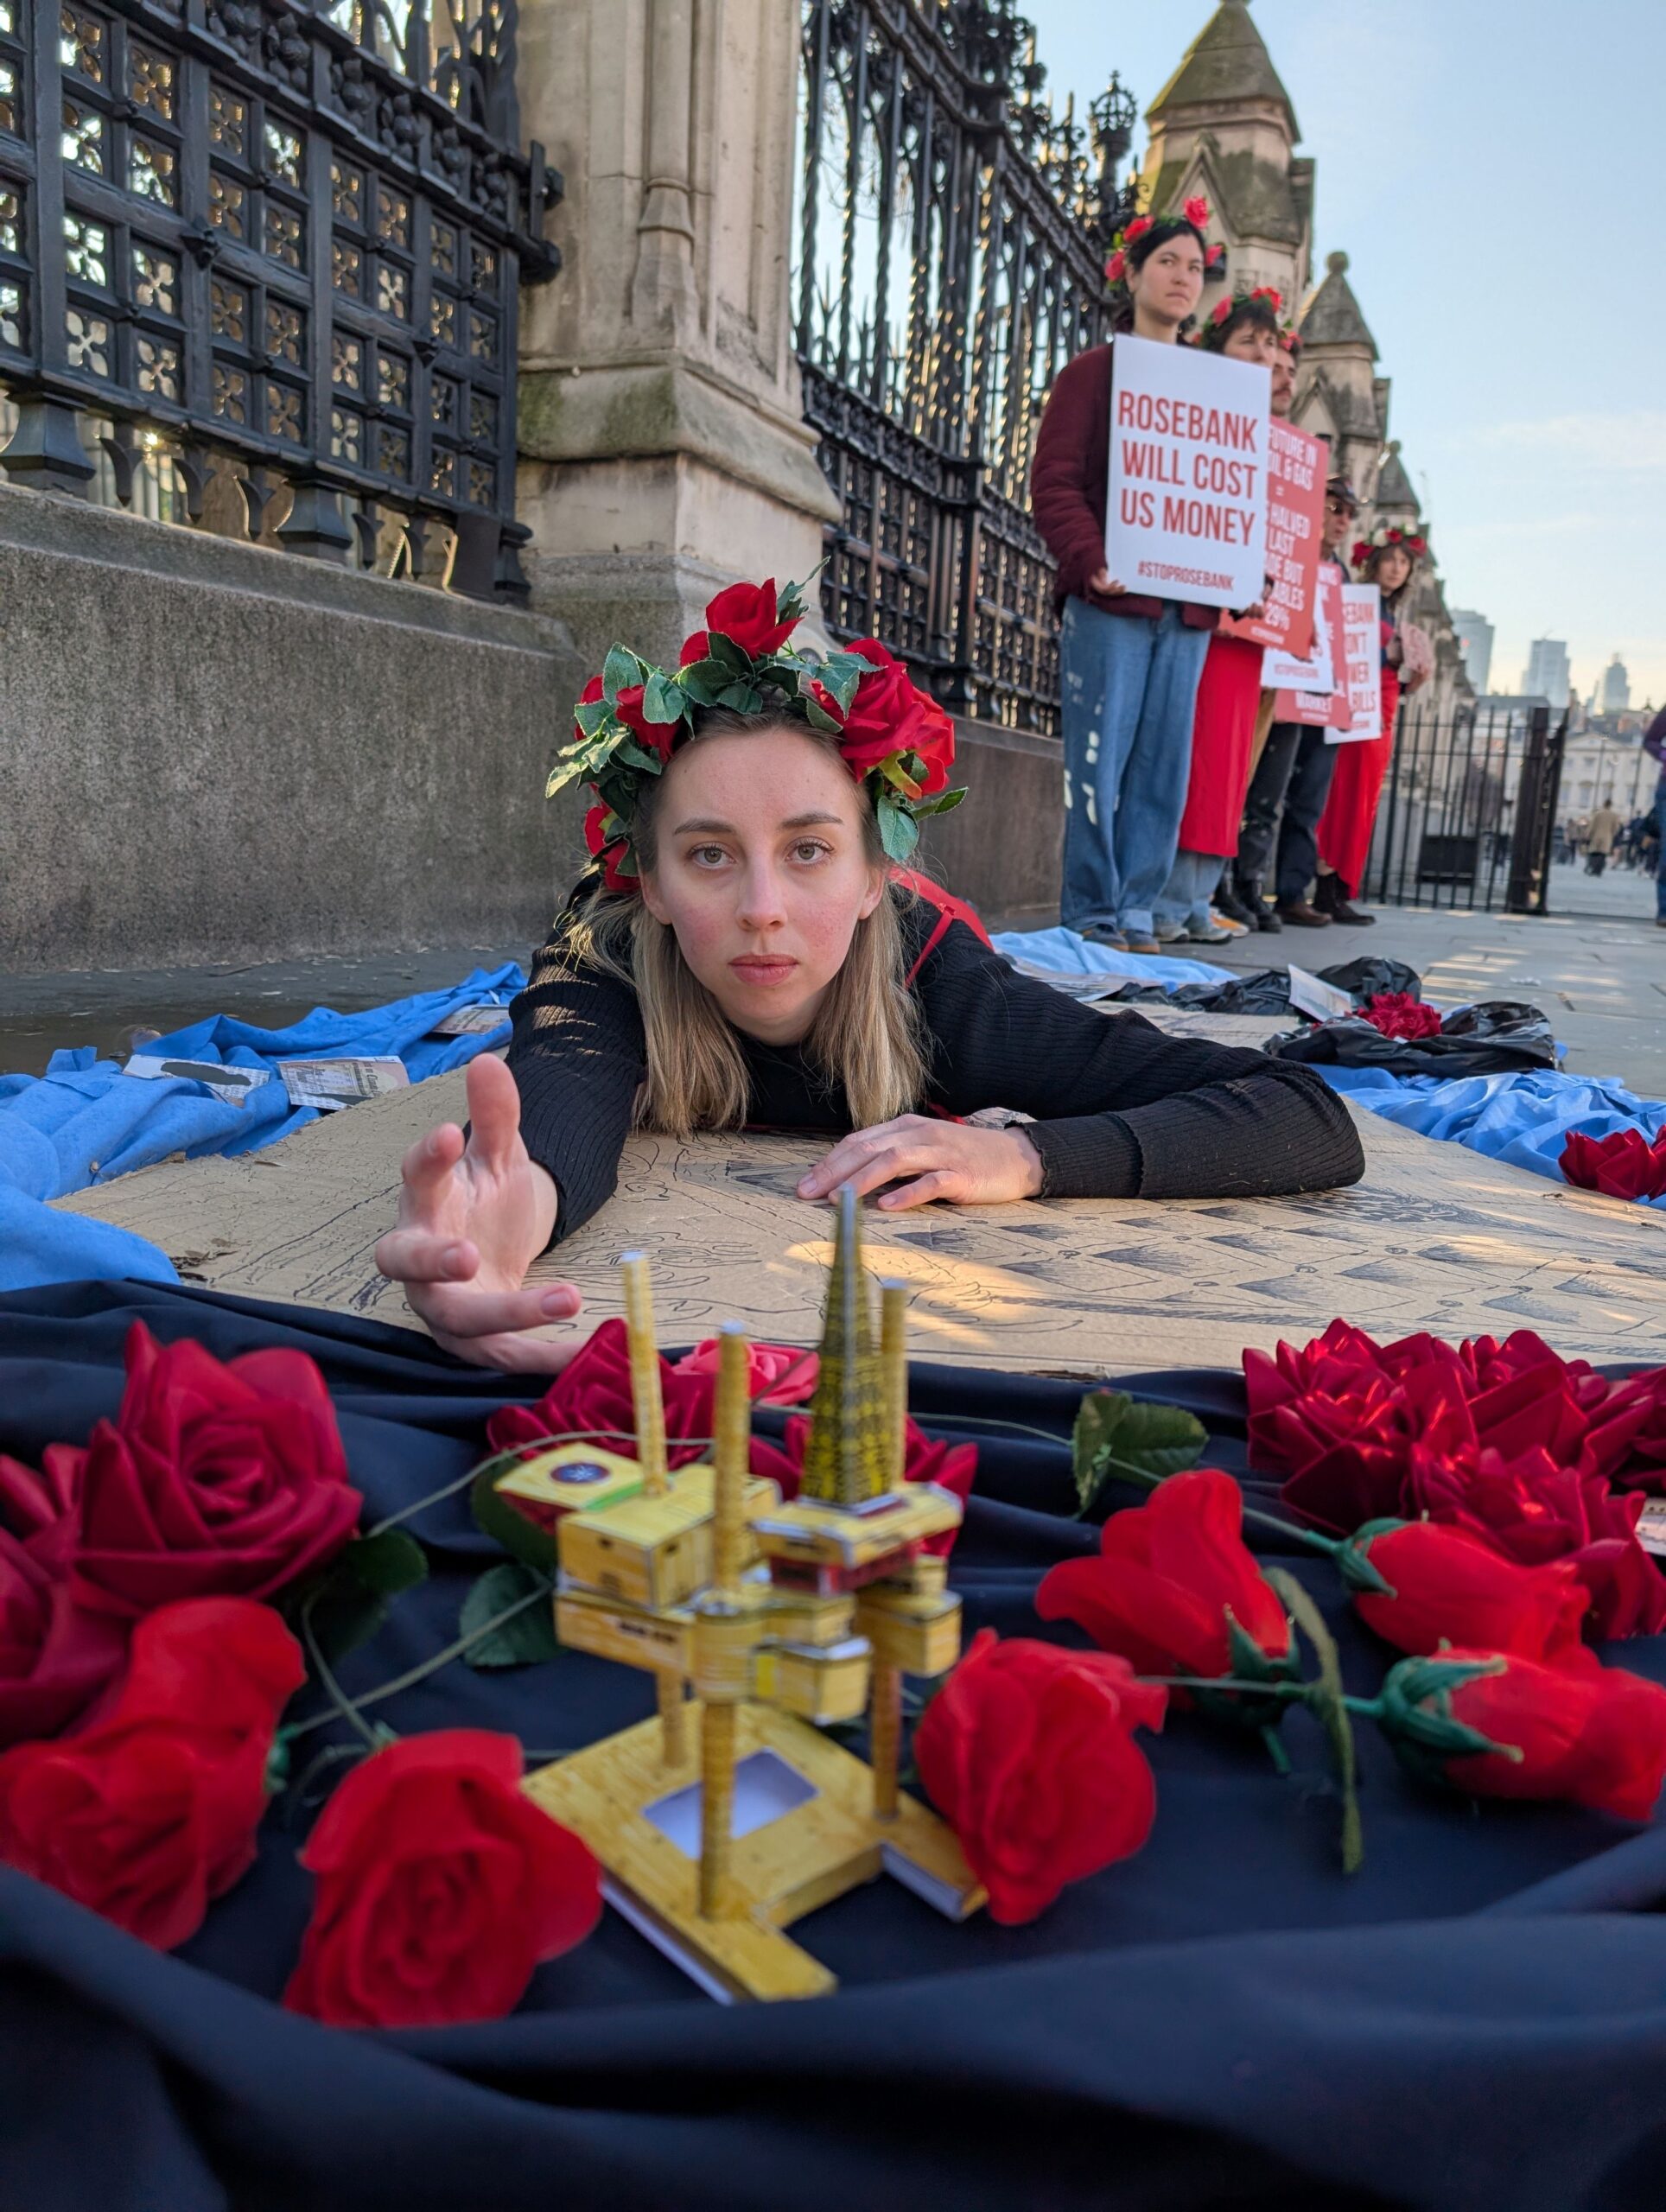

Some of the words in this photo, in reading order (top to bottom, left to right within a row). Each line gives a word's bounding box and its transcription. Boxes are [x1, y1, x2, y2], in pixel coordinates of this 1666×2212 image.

[1118, 391, 1257, 454] ROSEBANK
[1122, 440, 1185, 486] WILL
[1193, 454, 1257, 500] COST
[1306, 442, 1319, 469] IN
[1293, 461, 1313, 492] GAS
[1121, 488, 1155, 529] US
[1163, 496, 1255, 546] MONEY
[1270, 502, 1311, 540] HALVED
[1268, 524, 1295, 558] LAST
[1138, 561, 1234, 591] #STOPROSEBANK
[1282, 558, 1305, 587] BUT
[1270, 580, 1305, 612] ABLES
